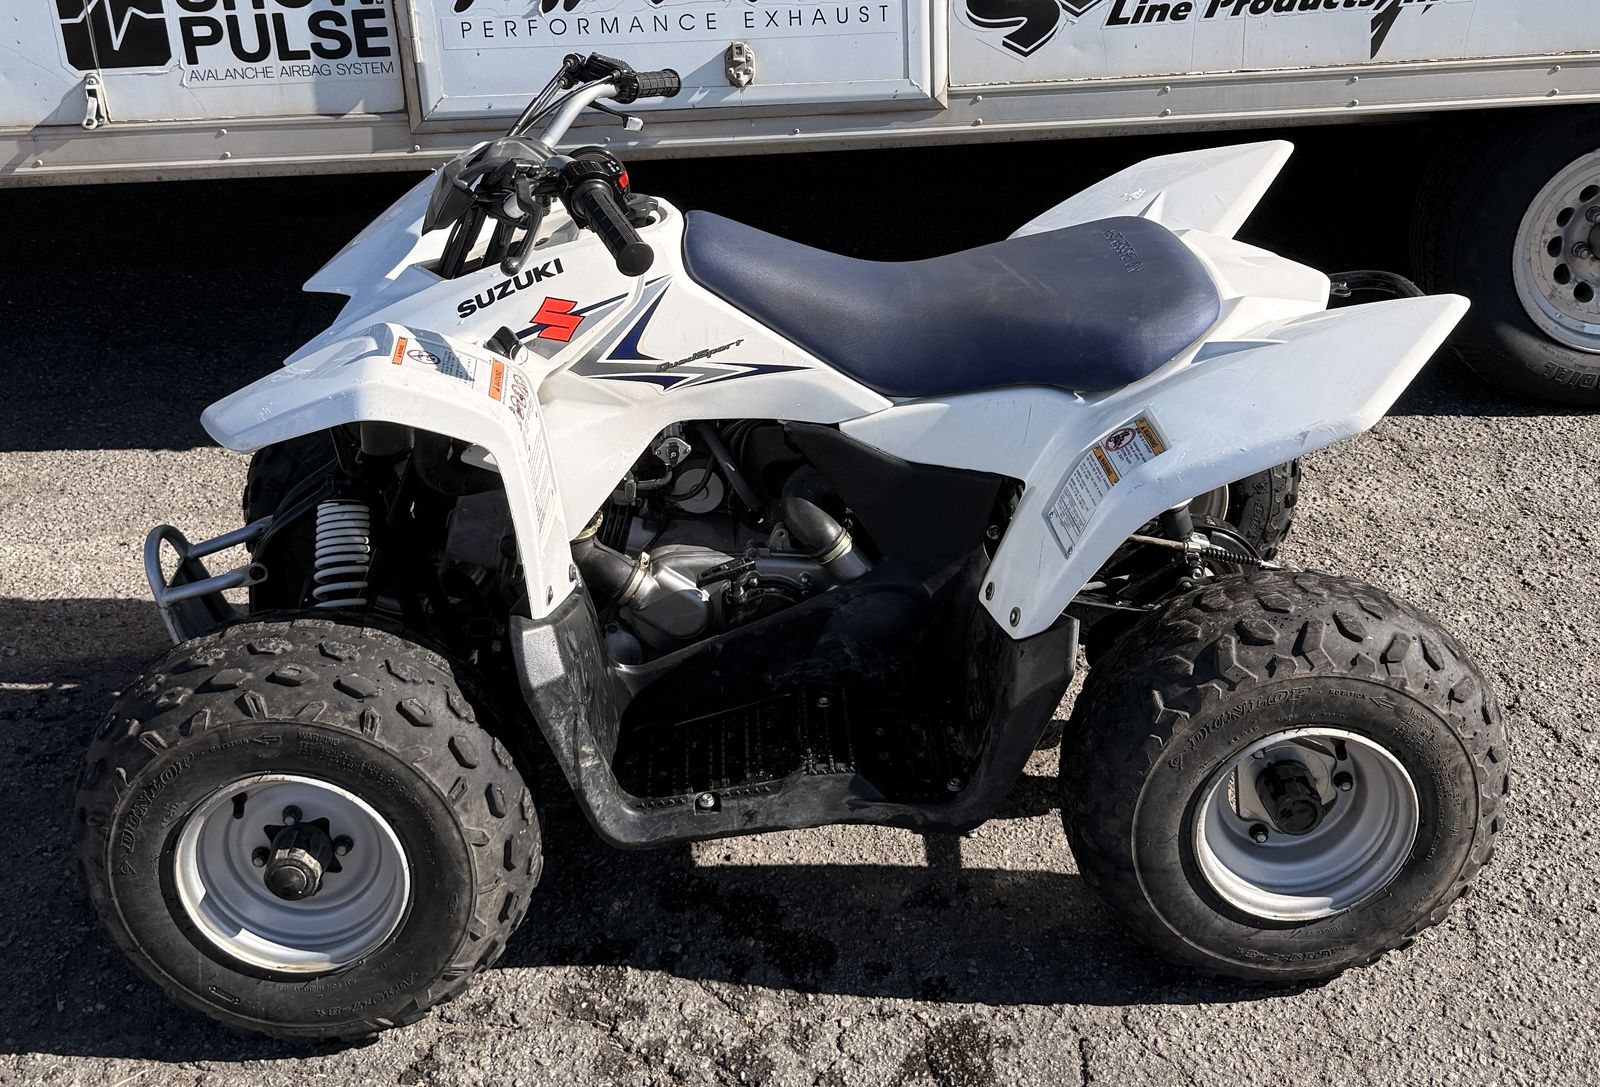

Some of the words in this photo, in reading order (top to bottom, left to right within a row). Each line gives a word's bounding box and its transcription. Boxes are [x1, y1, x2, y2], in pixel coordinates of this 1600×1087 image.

[460, 13, 717, 38] PERFORMANCE
[744, 5, 888, 28] EXHAUST
[1105, 0, 1193, 26] Line
[179, 8, 391, 65] PULSE
[189, 66, 274, 82] AVALANCHE
[280, 63, 331, 77] AIRBAG
[336, 61, 394, 75] SYSTEM
[457, 258, 564, 318] SUZUKI
